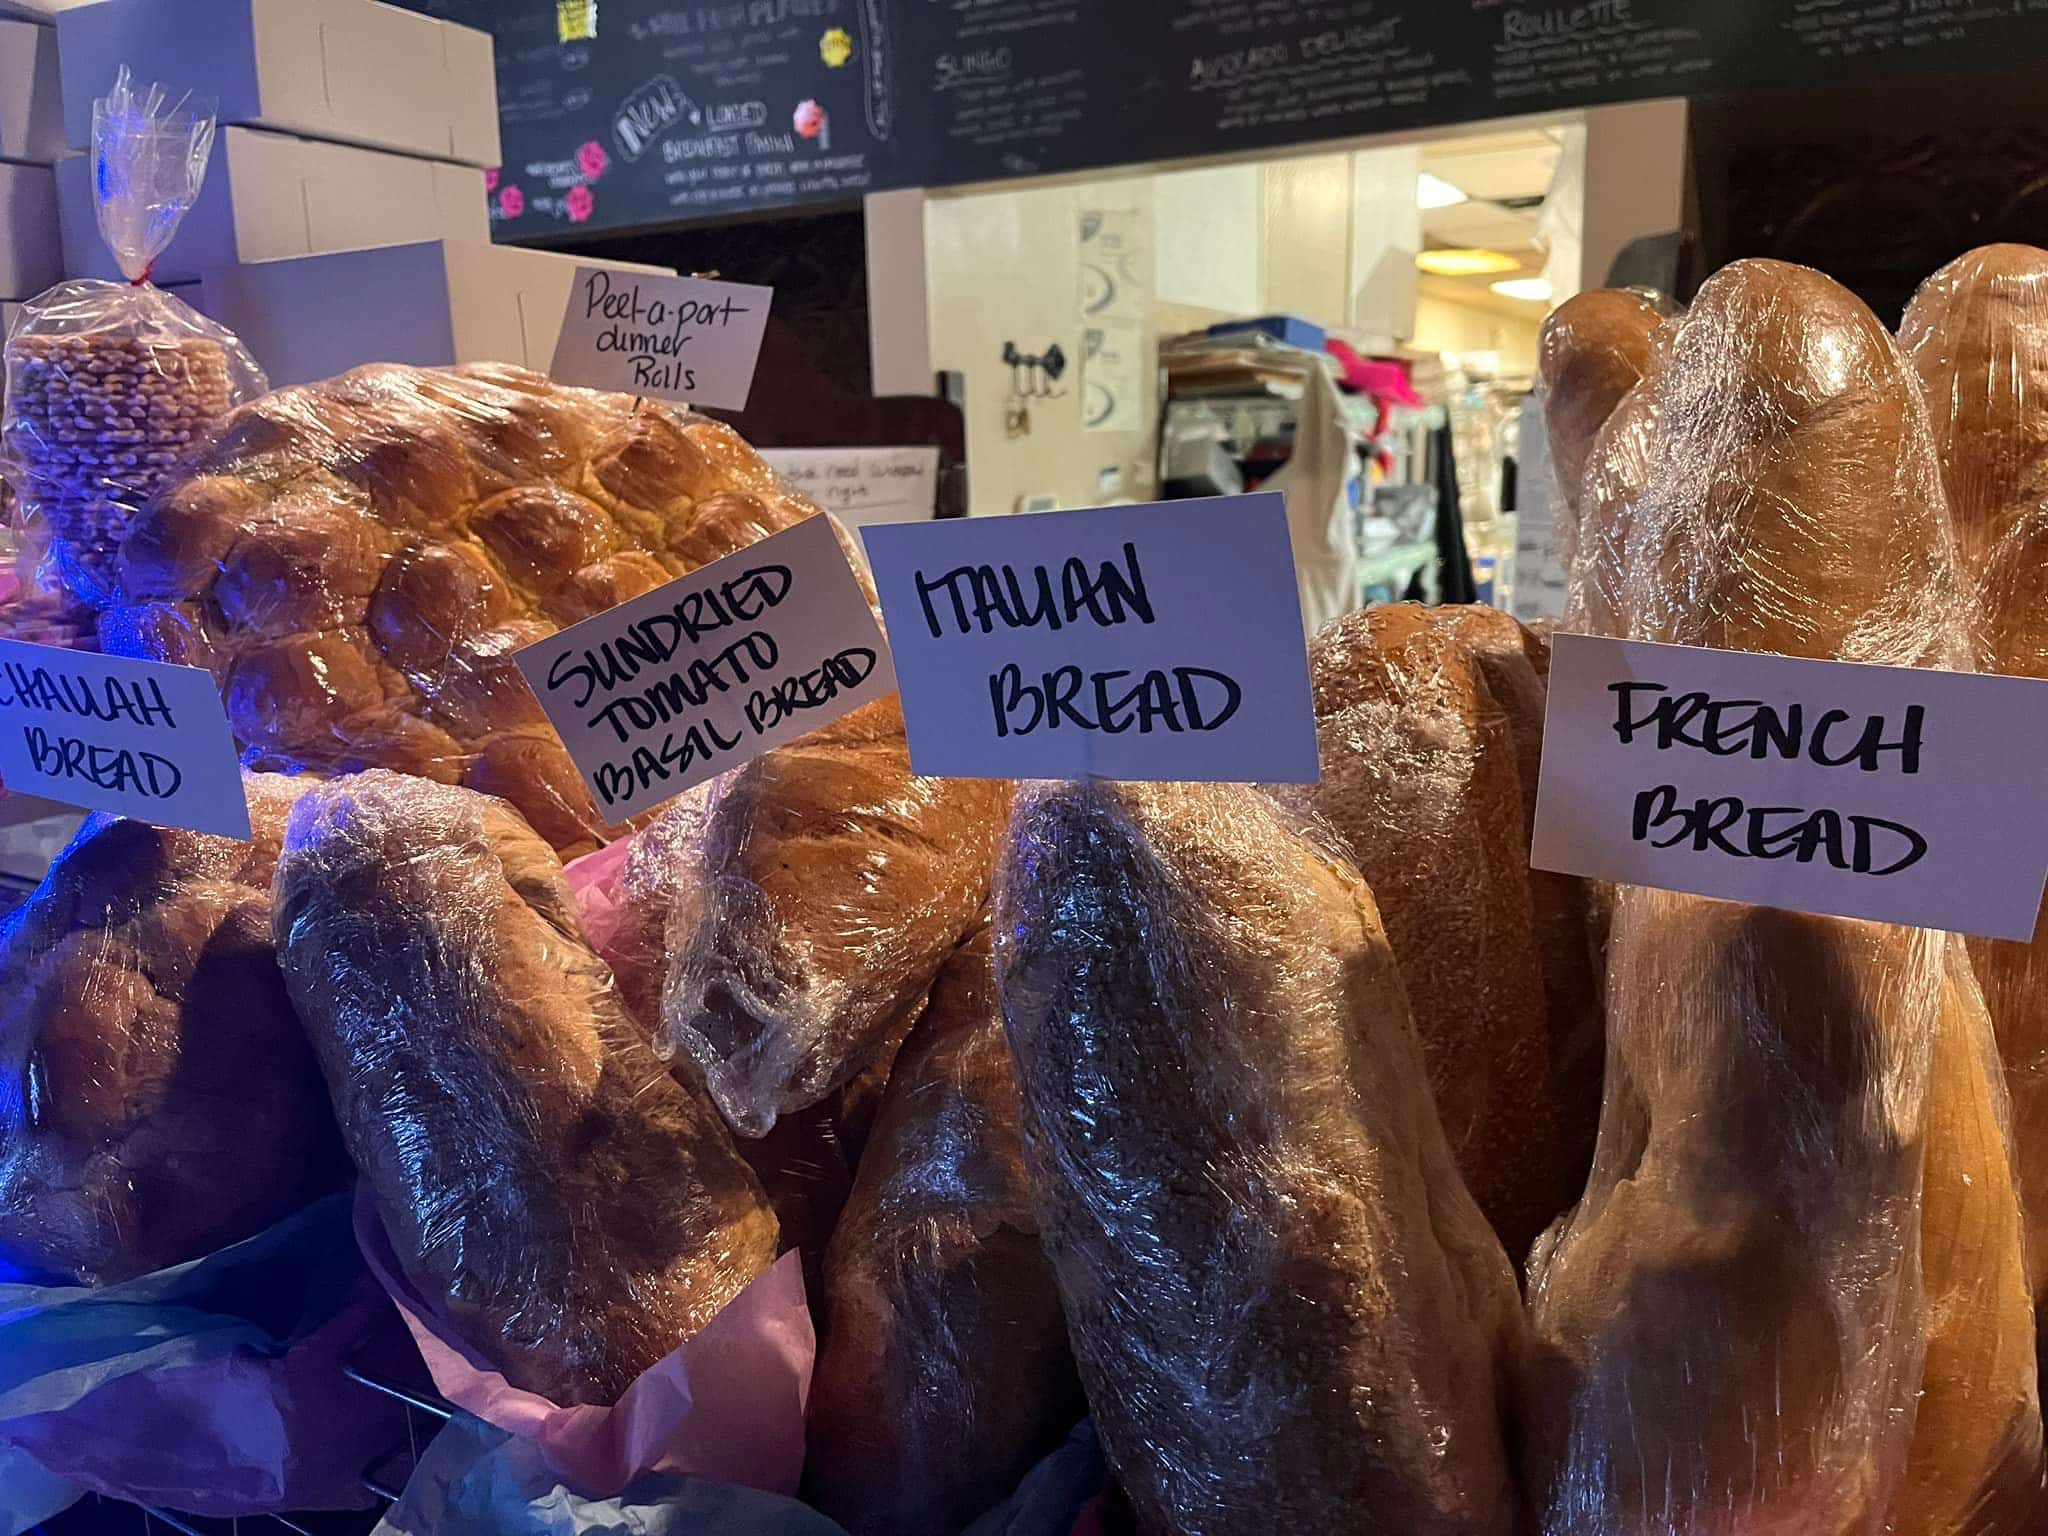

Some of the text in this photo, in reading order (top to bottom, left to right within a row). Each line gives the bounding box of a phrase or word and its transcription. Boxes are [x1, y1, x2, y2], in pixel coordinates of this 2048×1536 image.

[596, 324, 692, 358] dinner
[627, 355, 697, 391] Rolls
[547, 564, 793, 708] SUNDRIED
[914, 542, 1155, 638] ITALIAN
[587, 630, 779, 743] TOMATO
[592, 646, 877, 805] BASIL BREAD
[989, 662, 1243, 738] BREAD
[1607, 681, 1926, 774] FRENCH
[24, 725, 182, 799] BREAD
[1632, 784, 1928, 876] BREAD
